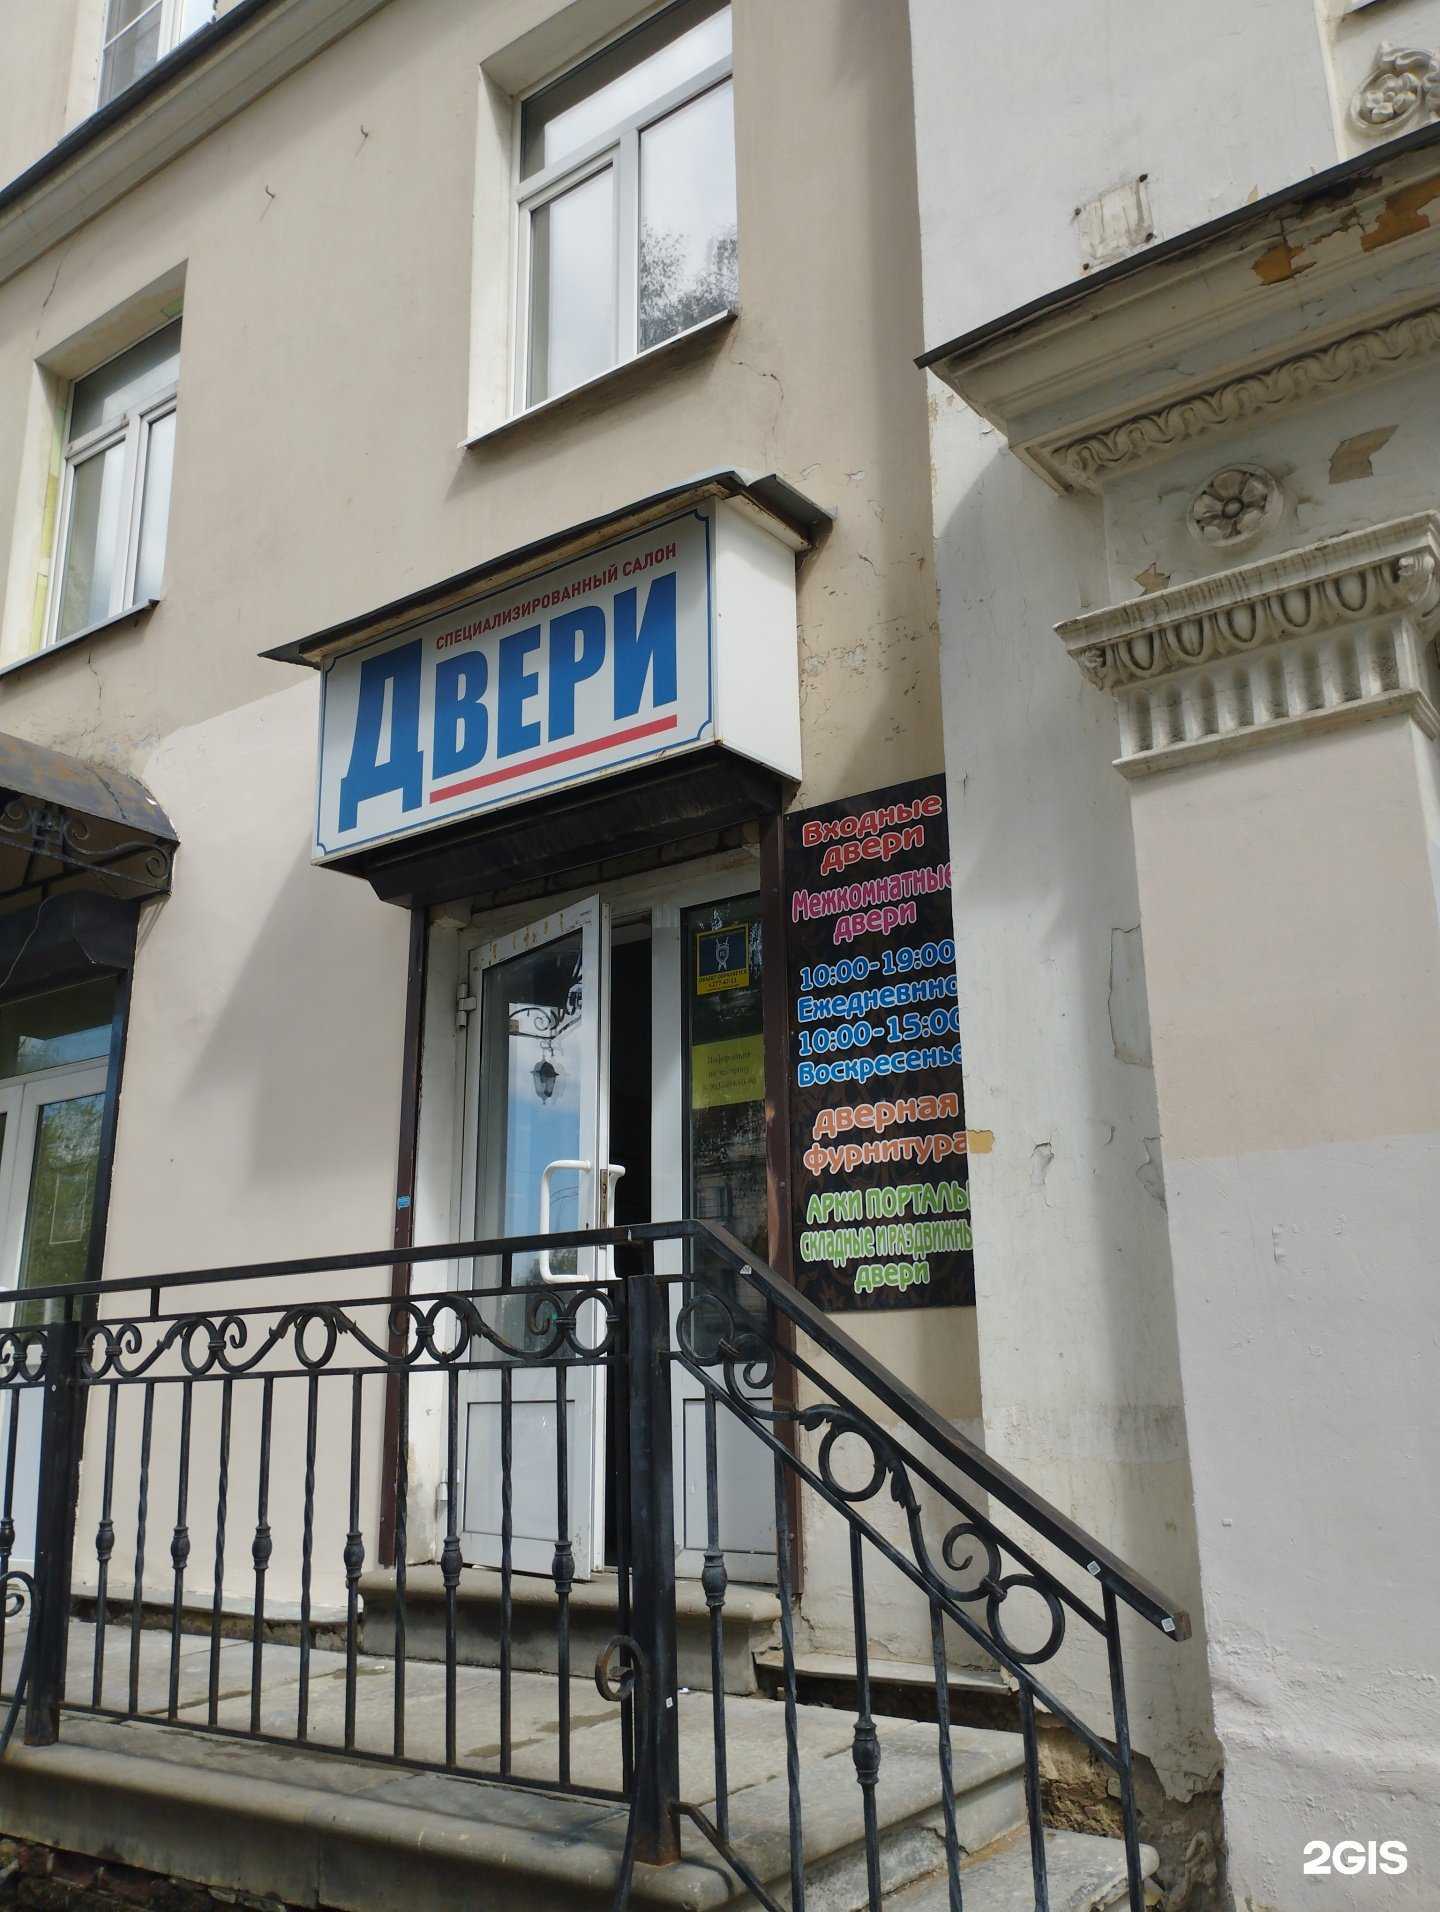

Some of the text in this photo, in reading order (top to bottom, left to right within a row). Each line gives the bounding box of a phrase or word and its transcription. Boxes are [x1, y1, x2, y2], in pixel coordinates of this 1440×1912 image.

[436, 542, 677, 650] СПЕЦИАЛИЗИРОВАННЫЙ САЛОН
[338, 571, 678, 834] ДВЕРИ
[802, 794, 942, 848] Входные
[821, 824, 925, 876] двери
[792, 862, 952, 923] Межкомнатные
[833, 900, 917, 945] двери
[800, 939, 956, 990] 10:00-19:00
[806, 1189, 863, 1224] АРКИ
[853, 1261, 930, 1294] двери
